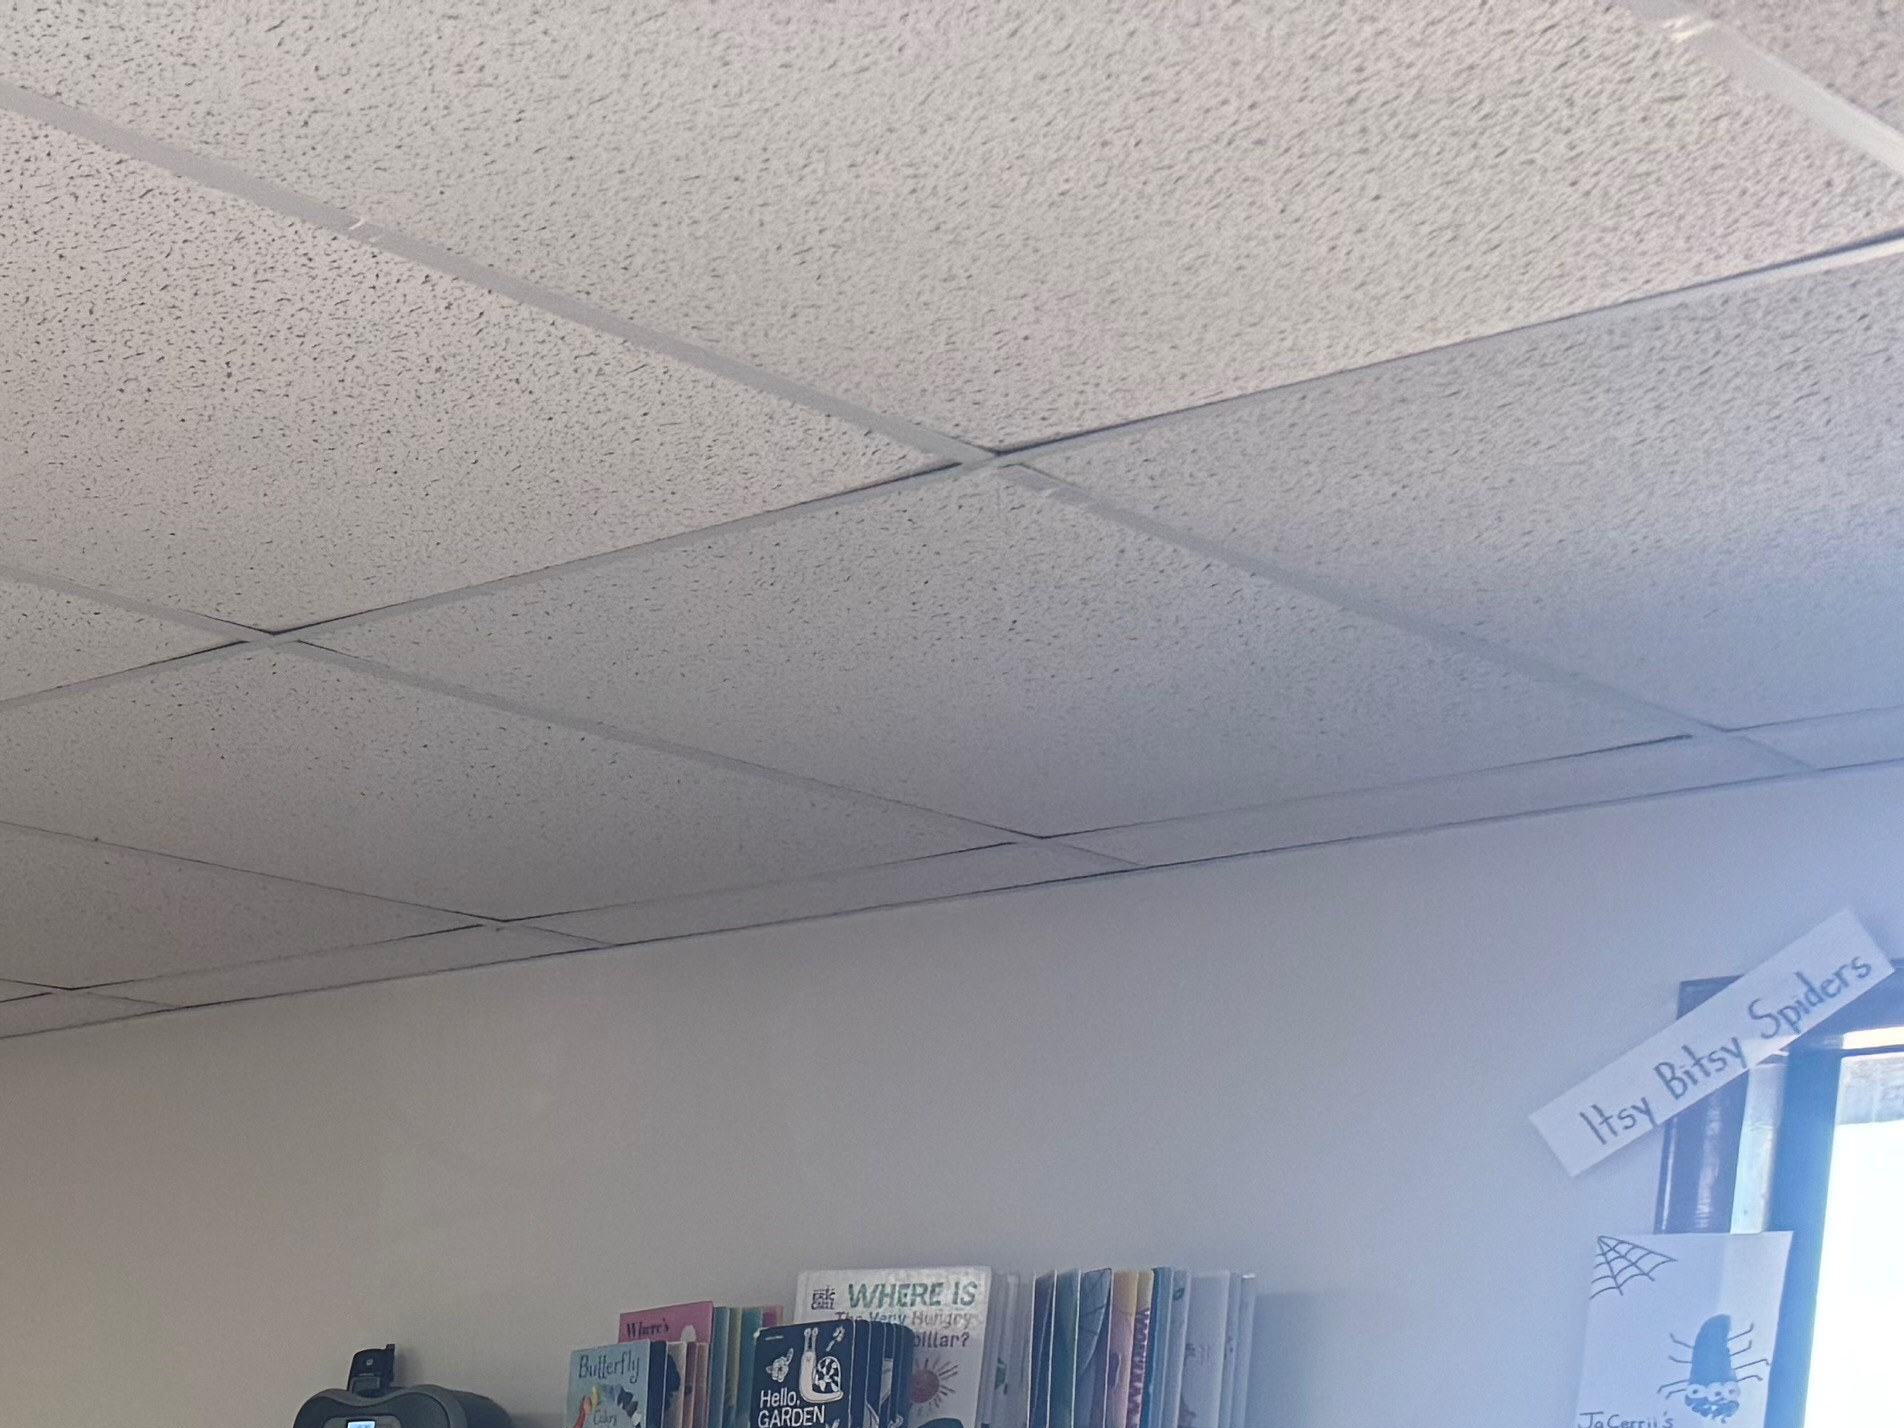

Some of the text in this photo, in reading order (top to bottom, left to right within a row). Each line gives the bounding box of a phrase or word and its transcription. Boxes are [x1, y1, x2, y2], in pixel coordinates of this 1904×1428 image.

[1579, 956, 1872, 1145] Itsy Bitsy Spiders
[848, 1281, 978, 1308] WHERE IS
[626, 1318, 669, 1338] Where's
[912, 1311, 972, 1327] Hungry
[578, 1349, 640, 1384] Butterfly
[760, 1387, 799, 1408] Hello,
[758, 1405, 825, 1428] GARDEN
